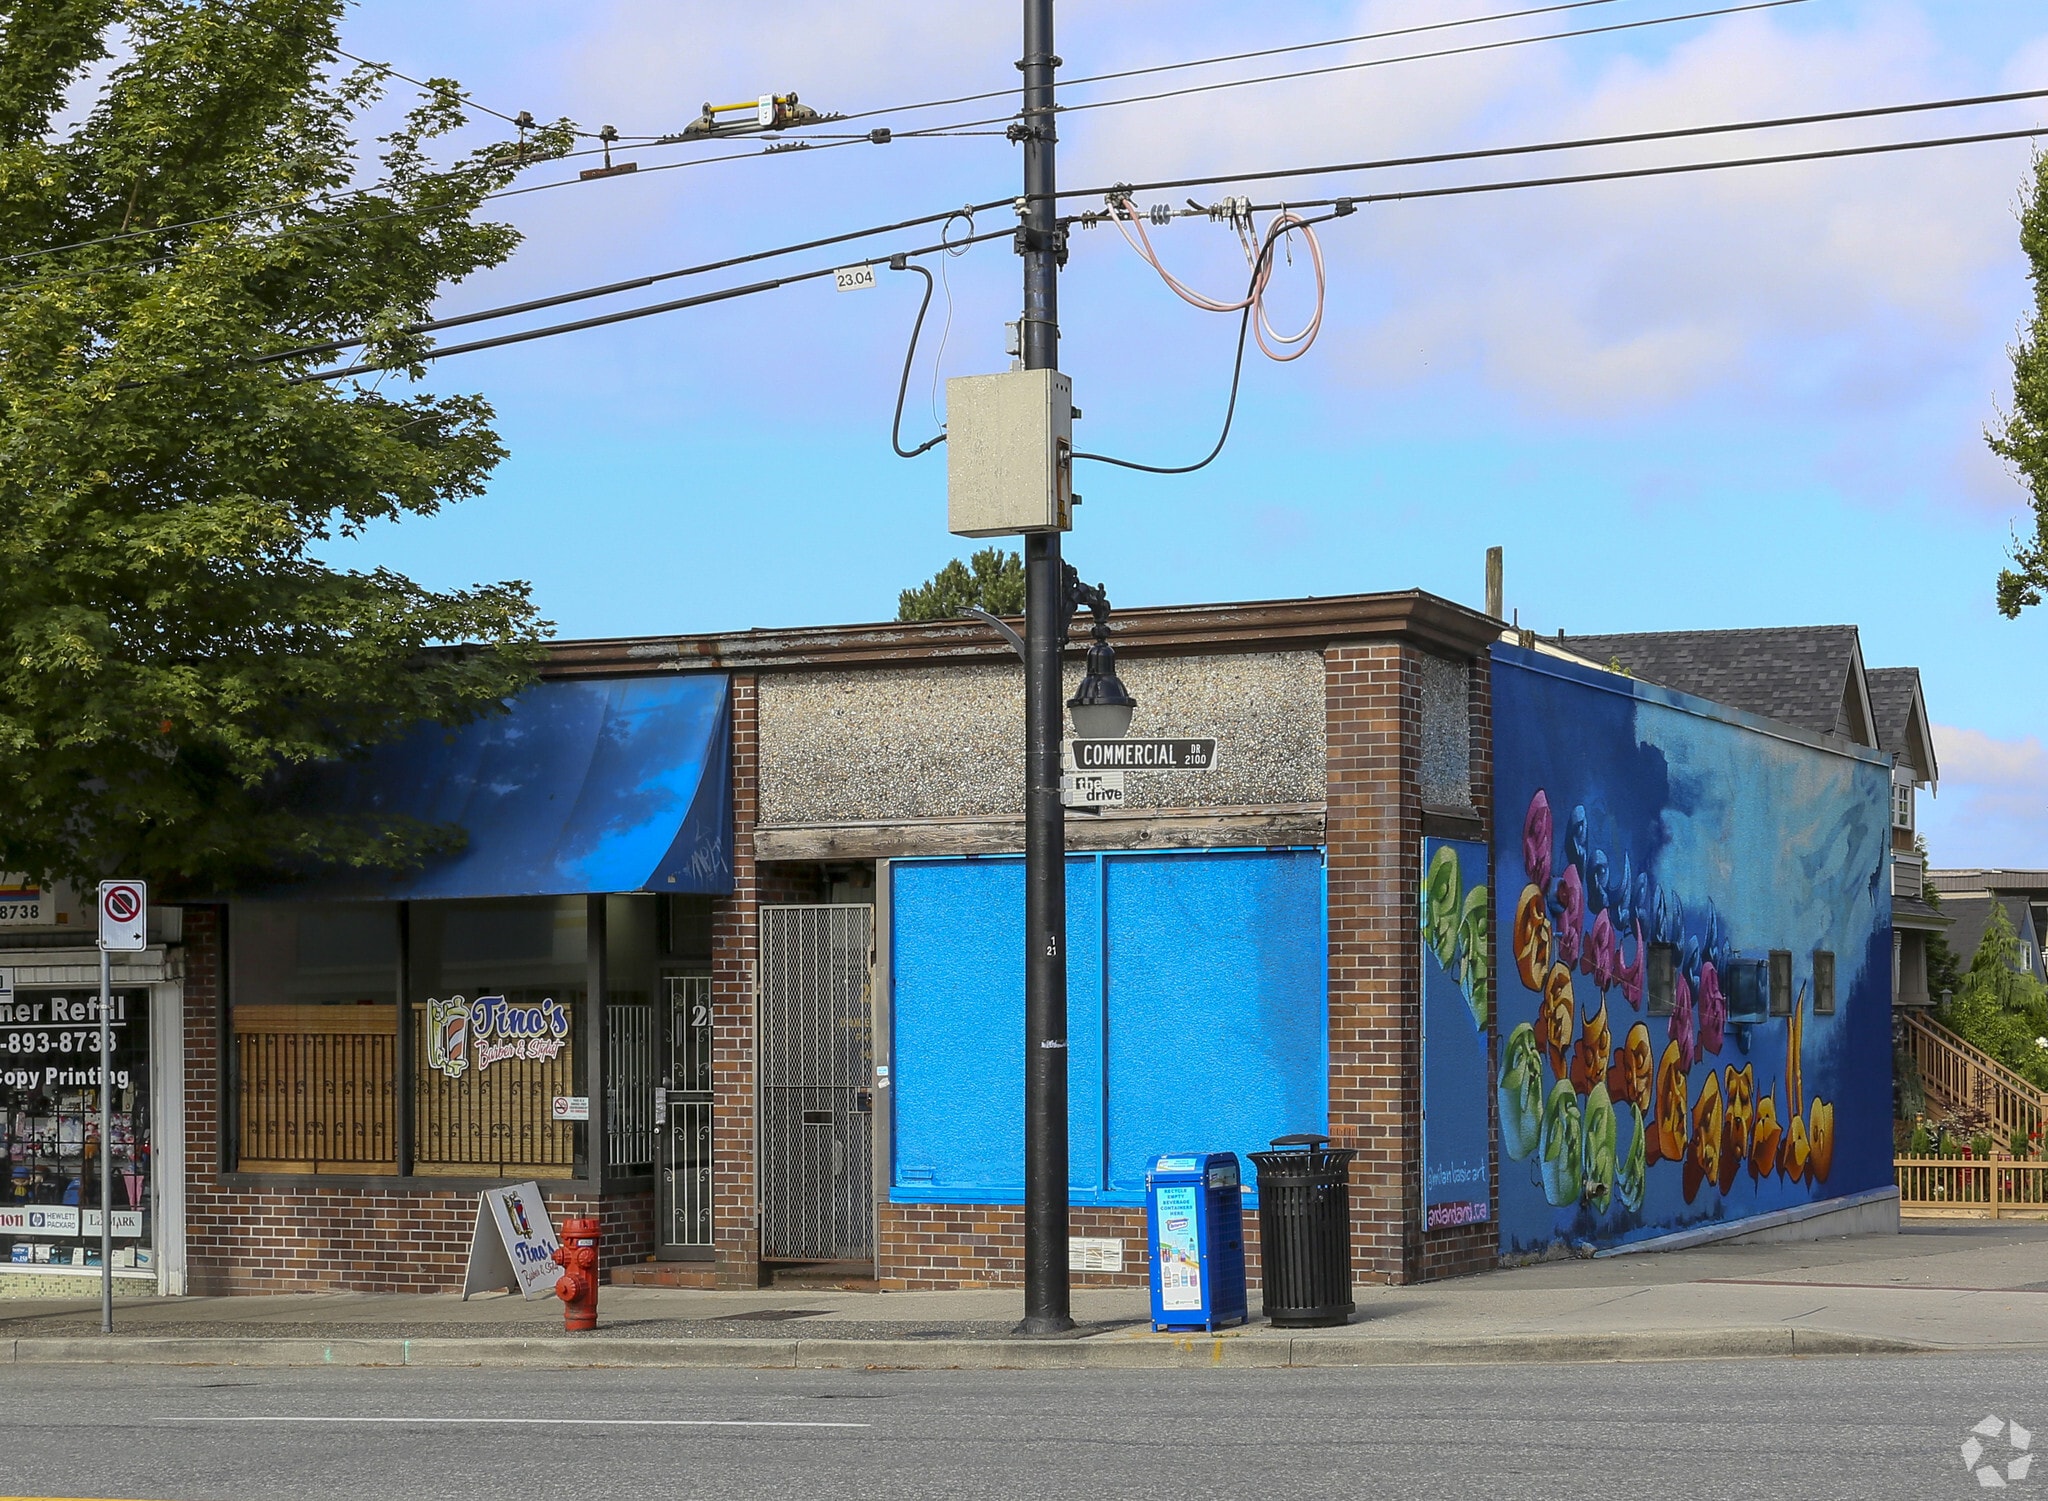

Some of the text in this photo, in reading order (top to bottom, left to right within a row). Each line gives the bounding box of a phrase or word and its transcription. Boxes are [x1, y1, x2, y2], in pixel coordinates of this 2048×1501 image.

[837, 271, 872, 287] 23.04
[1083, 744, 1177, 766] COMMERCIAL
[1190, 743, 1201, 754] DR
[1184, 754, 1207, 765] 2100
[1077, 777, 1102, 790] the
[1086, 788, 1122, 801] drive
[0, 904, 40, 920] 8738
[1051, 936, 1055, 945] 1
[1047, 946, 1056, 956] 21
[51, 995, 125, 1021] Refll
[471, 995, 568, 1038] Tino's
[474, 1038, 565, 1071] Barber & Stylist
[0, 1067, 40, 1090] opy
[46, 1212, 76, 1220] HEWLETT
[46, 1221, 76, 1229] PACKARD
[515, 1239, 556, 1266] Tino's
